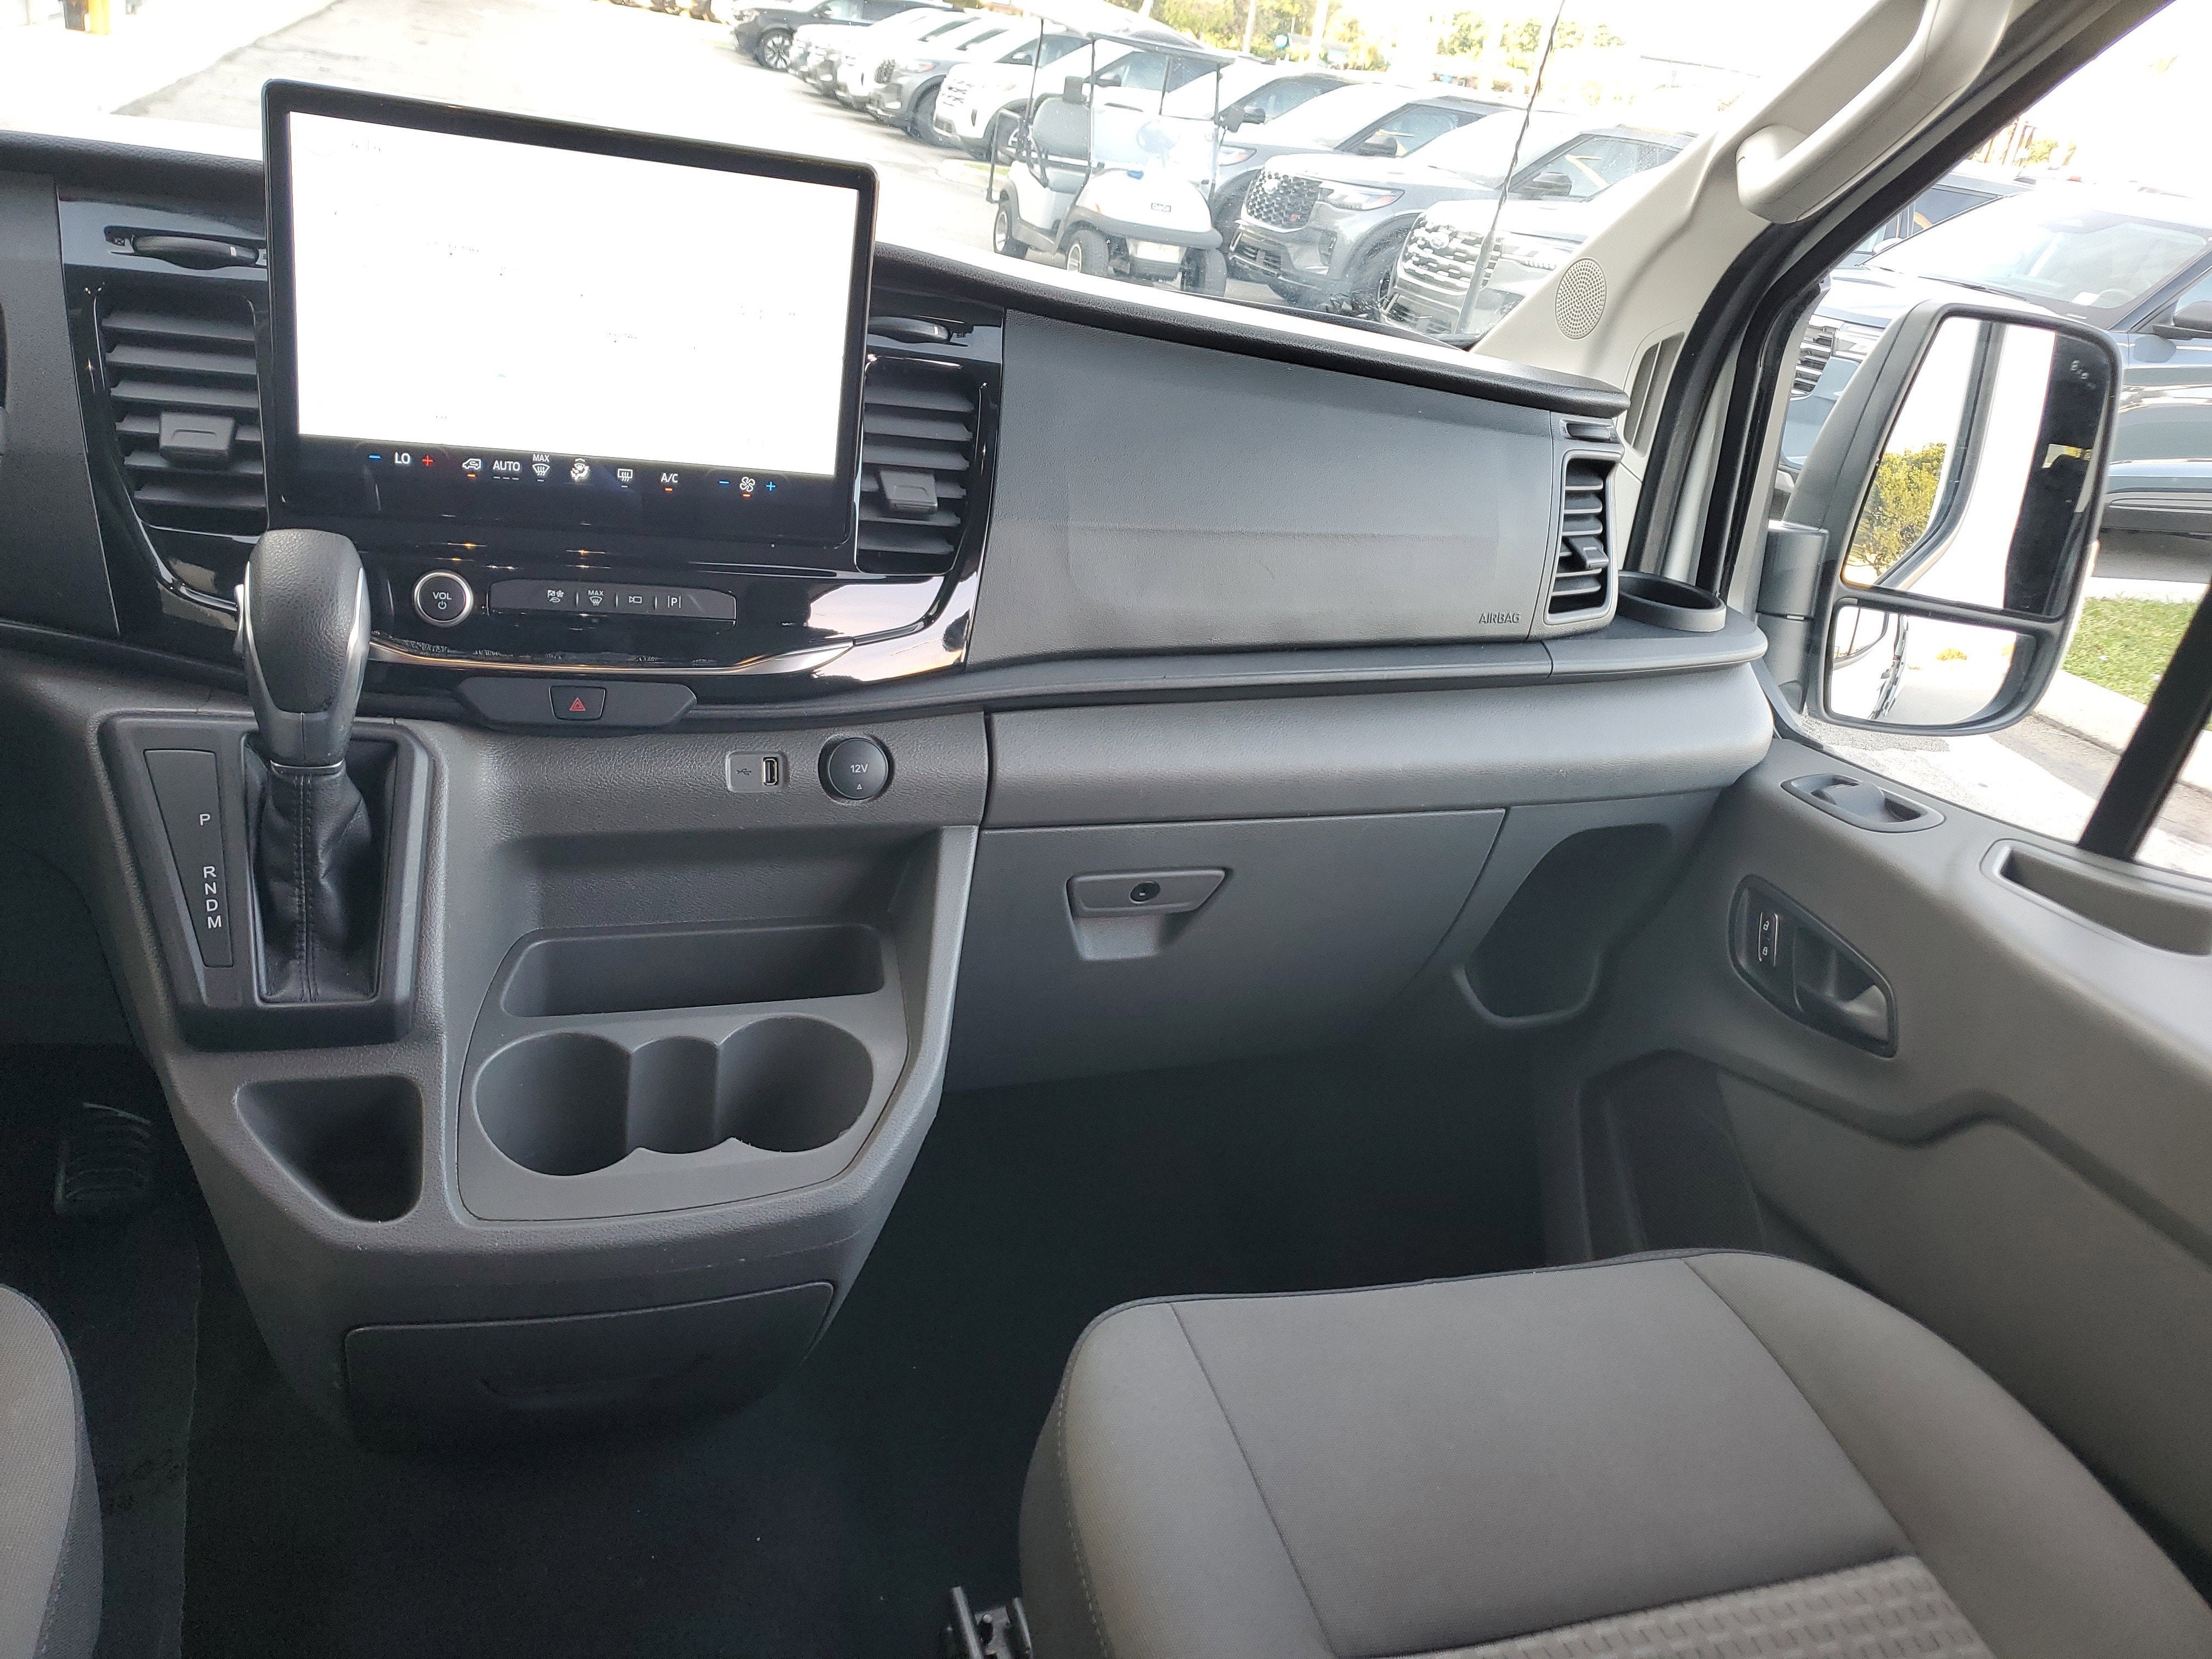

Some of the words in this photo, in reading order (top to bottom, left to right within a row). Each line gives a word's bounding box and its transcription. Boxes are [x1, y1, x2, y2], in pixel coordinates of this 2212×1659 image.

[394, 452, 410, 464] LO
[533, 454, 550, 462] MAX
[493, 460, 521, 471] AUTO
[661, 472, 679, 483] A/C
[432, 591, 453, 600] VOL
[1479, 612, 1520, 624] AIRBAG
[850, 763, 868, 773] 12V
[199, 813, 211, 826] P
[203, 865, 217, 878] R
[205, 882, 217, 895] N
[206, 899, 218, 912] D
[207, 915, 222, 929] M
